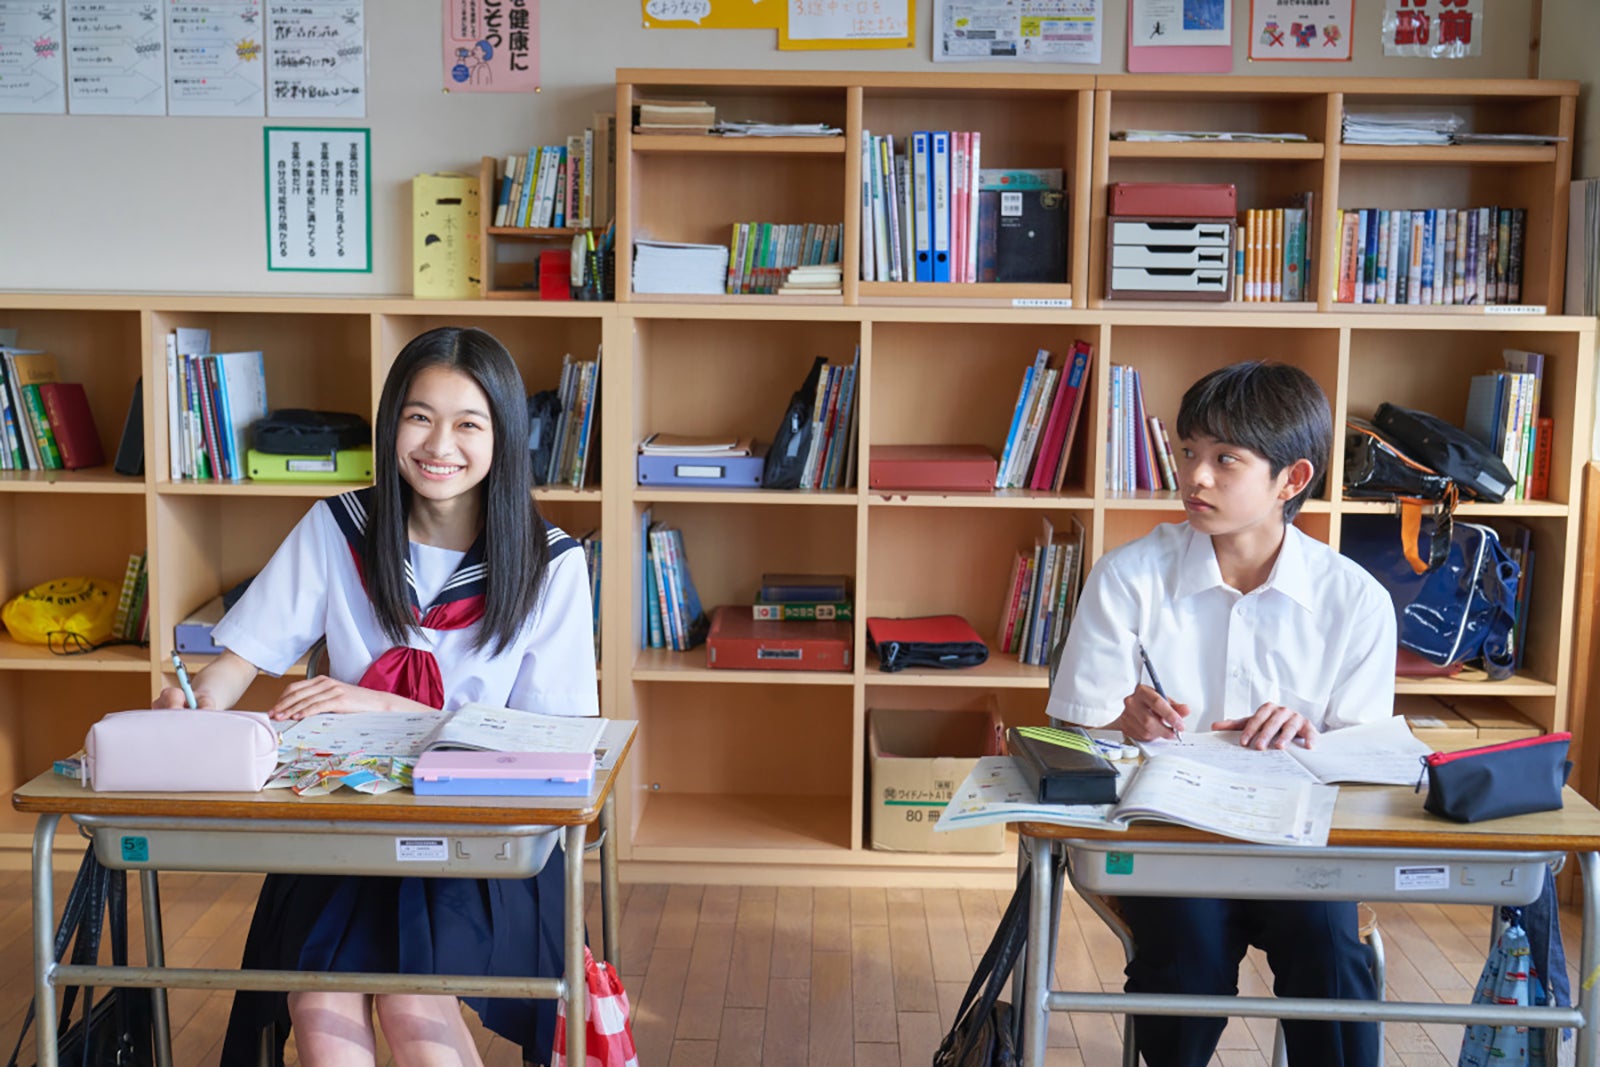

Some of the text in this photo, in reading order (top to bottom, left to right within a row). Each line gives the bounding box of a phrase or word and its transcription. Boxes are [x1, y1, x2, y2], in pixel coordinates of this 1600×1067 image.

[1394, 0, 1430, 45] 動
[1438, 0, 1473, 44] 前
[906, 809, 923, 822] 80
[124, 838, 135, 850] 5
